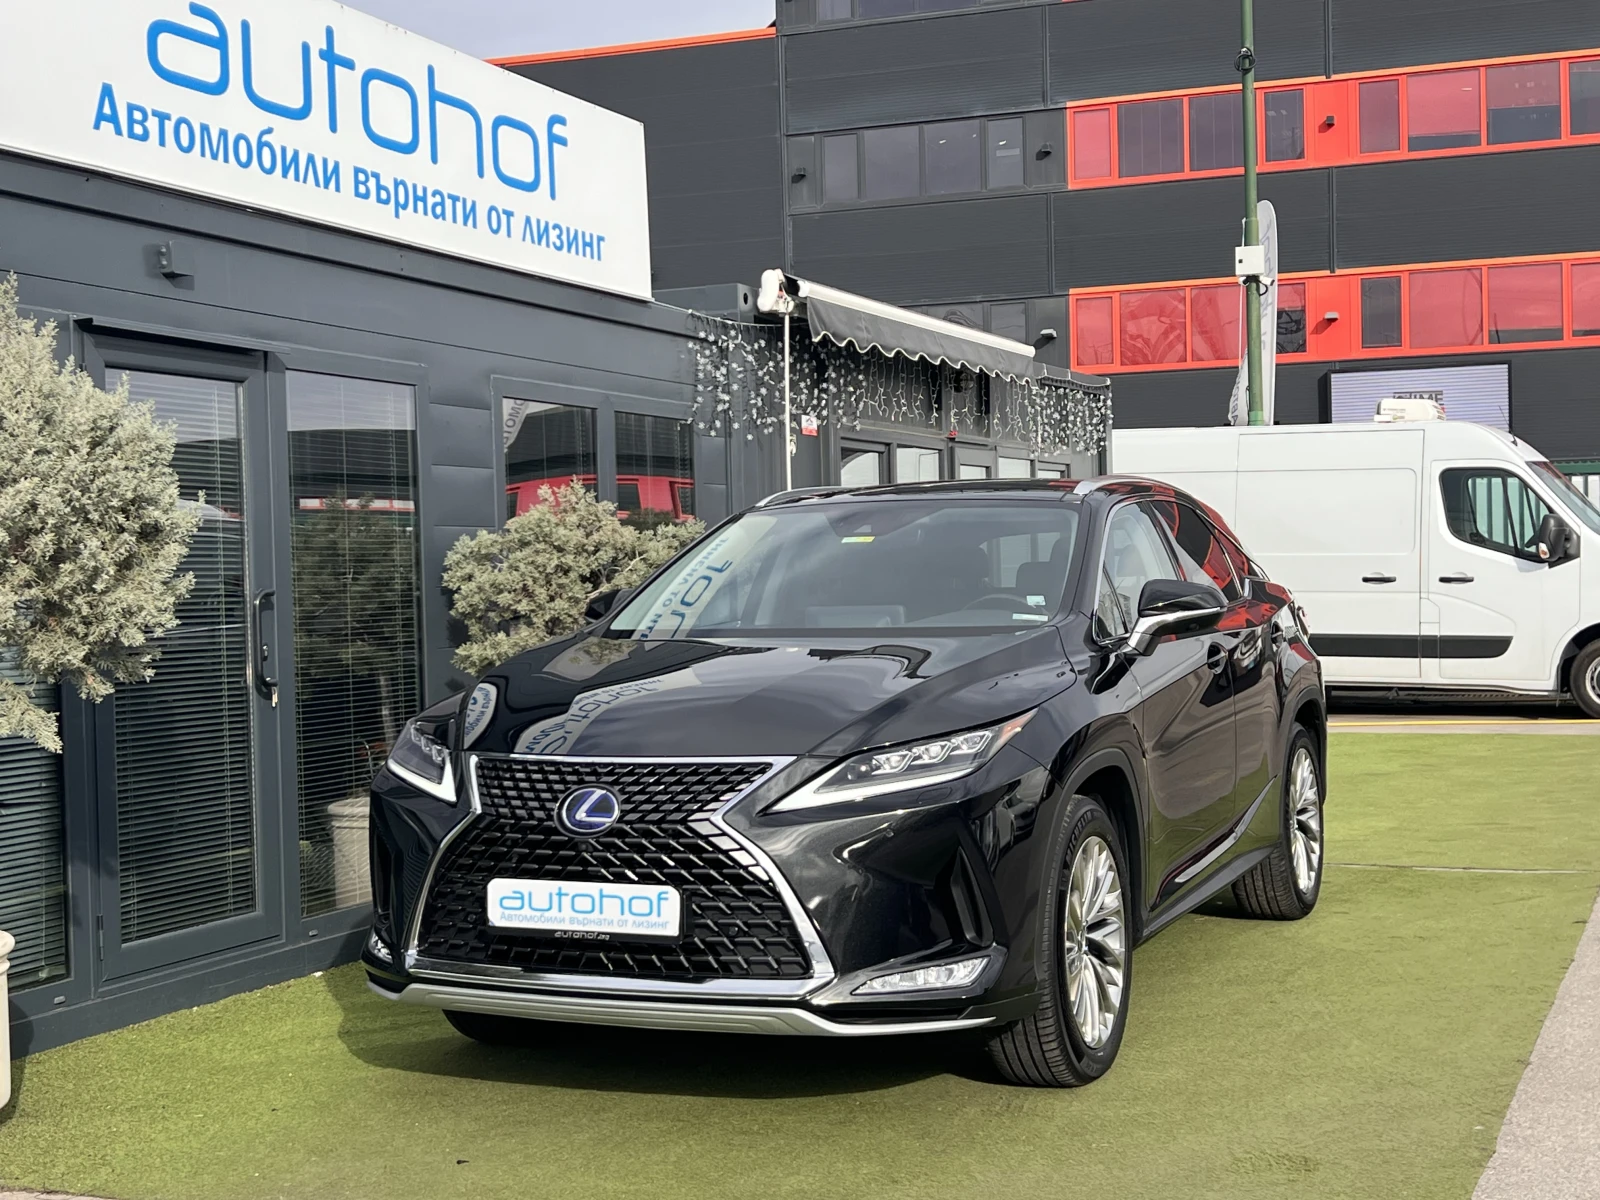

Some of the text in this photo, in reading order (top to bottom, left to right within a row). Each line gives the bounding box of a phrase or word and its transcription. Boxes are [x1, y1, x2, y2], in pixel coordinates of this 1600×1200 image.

[147, 2, 568, 199] autohof
[93, 83, 605, 260] Автомобили върнати от лизинг
[499, 886, 670, 918] autohof
[500, 911, 670, 930] Автомобили върнати от лизинг
